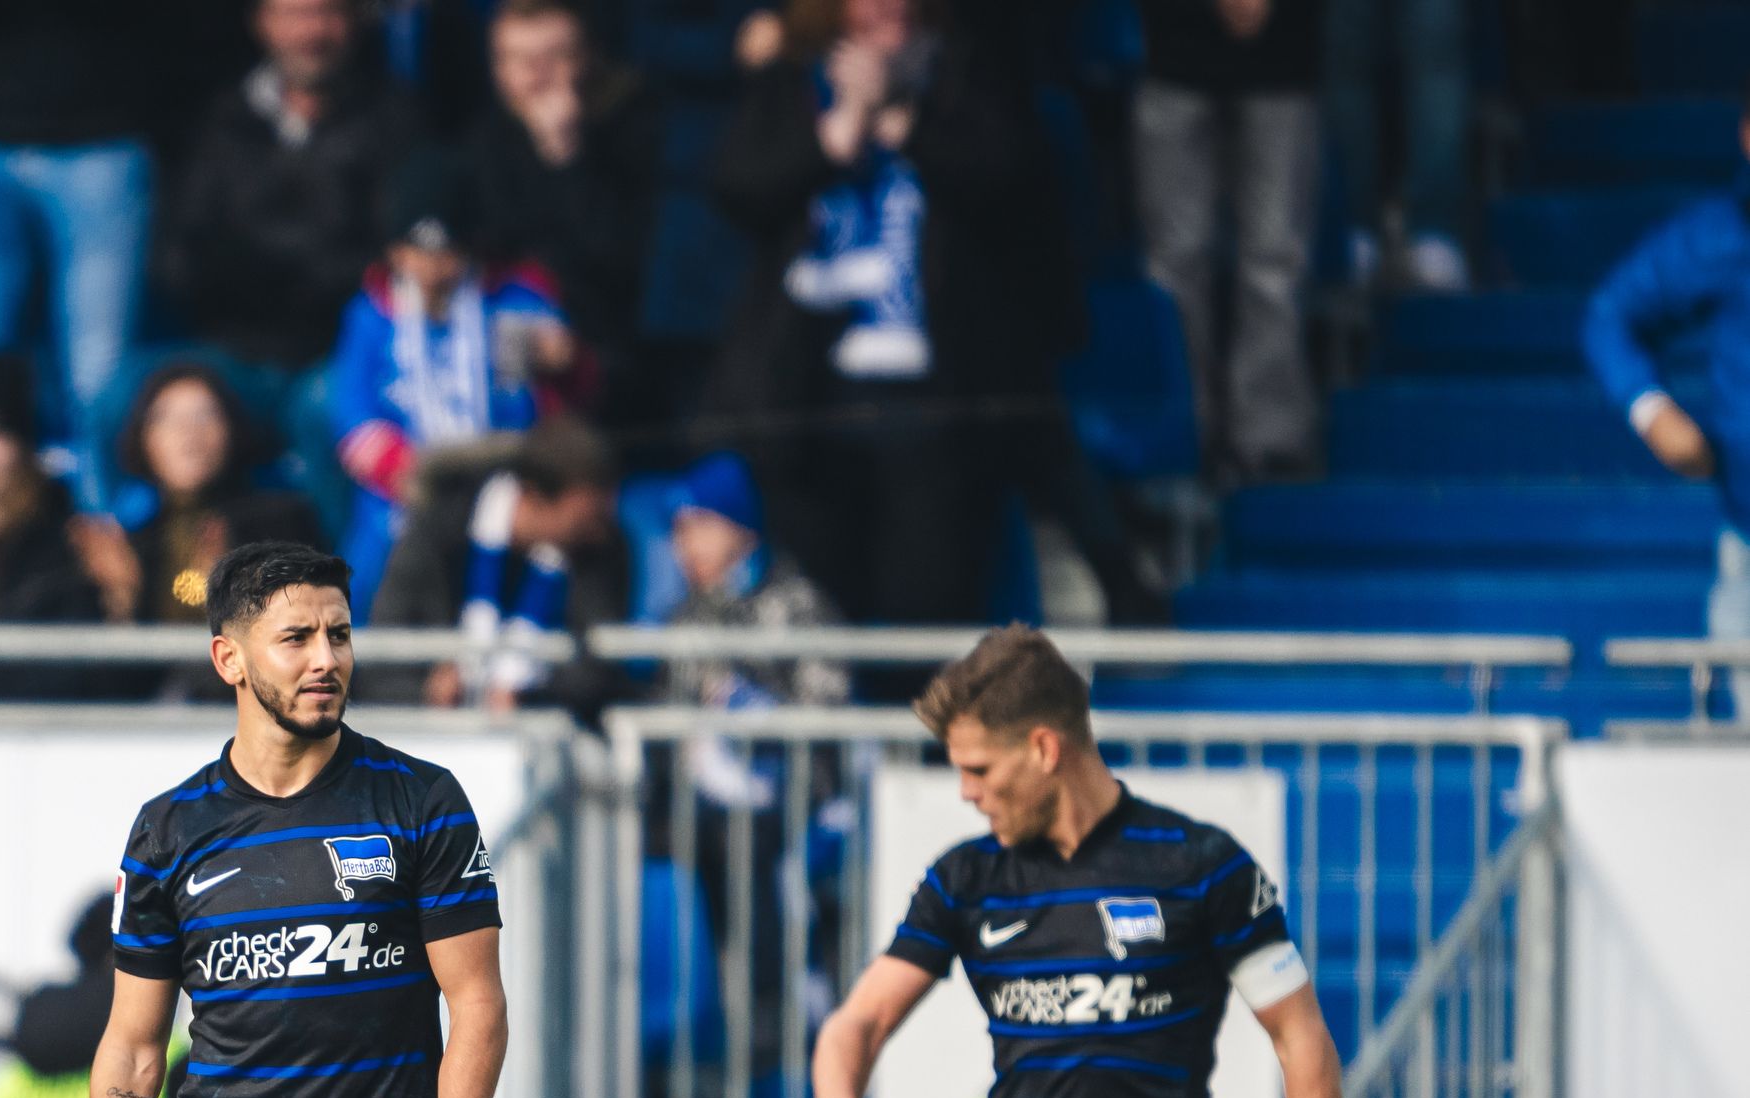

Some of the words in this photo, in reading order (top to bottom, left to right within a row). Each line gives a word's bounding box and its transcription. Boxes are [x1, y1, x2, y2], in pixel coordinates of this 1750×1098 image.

[343, 861, 374, 875] Hertha
[374, 859, 392, 873] BSC
[220, 926, 296, 958] check
[215, 952, 286, 982] CARS
[1064, 973, 1136, 1024] 24
